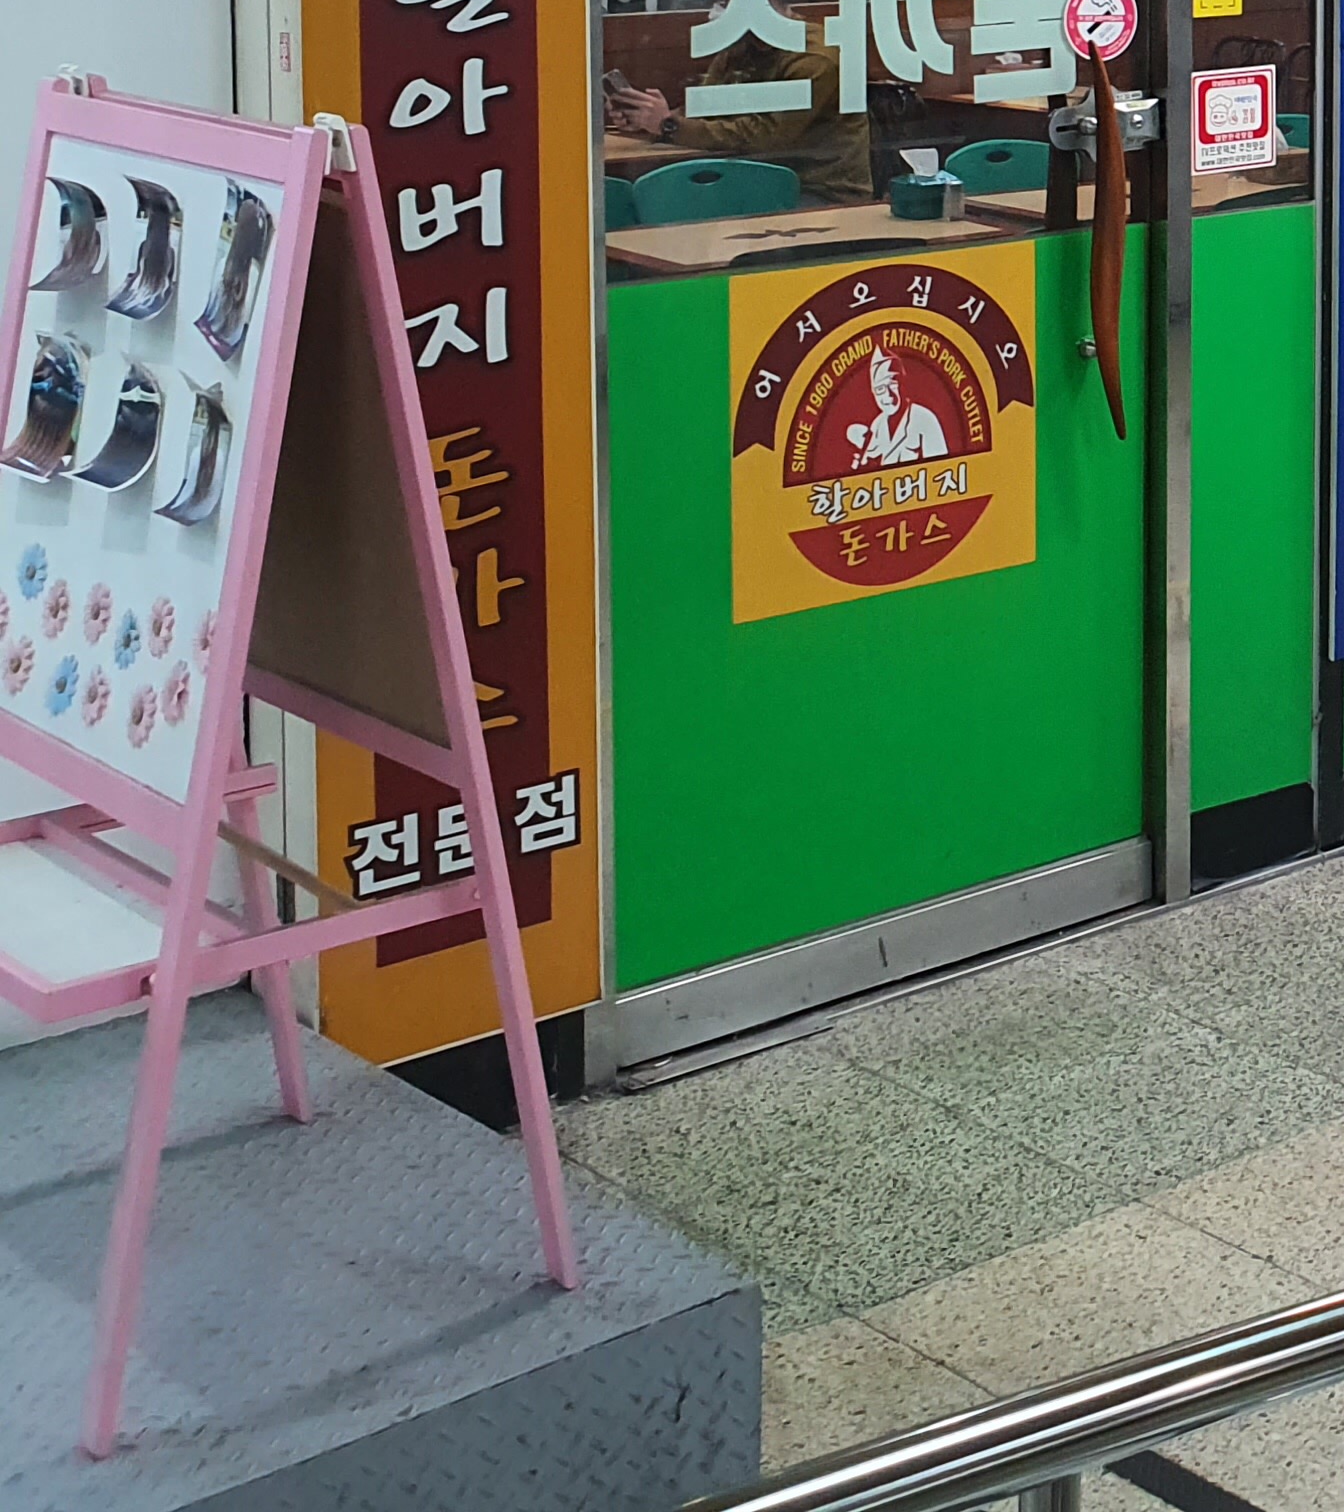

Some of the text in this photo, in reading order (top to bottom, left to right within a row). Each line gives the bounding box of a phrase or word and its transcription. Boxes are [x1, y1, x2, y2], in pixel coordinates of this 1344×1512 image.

[792, 328, 984, 472] SINCE 1960 GRAND FATHER'S PORK CUTLET
[809, 464, 967, 523] 할아버지
[839, 514, 952, 567] 돈가스
